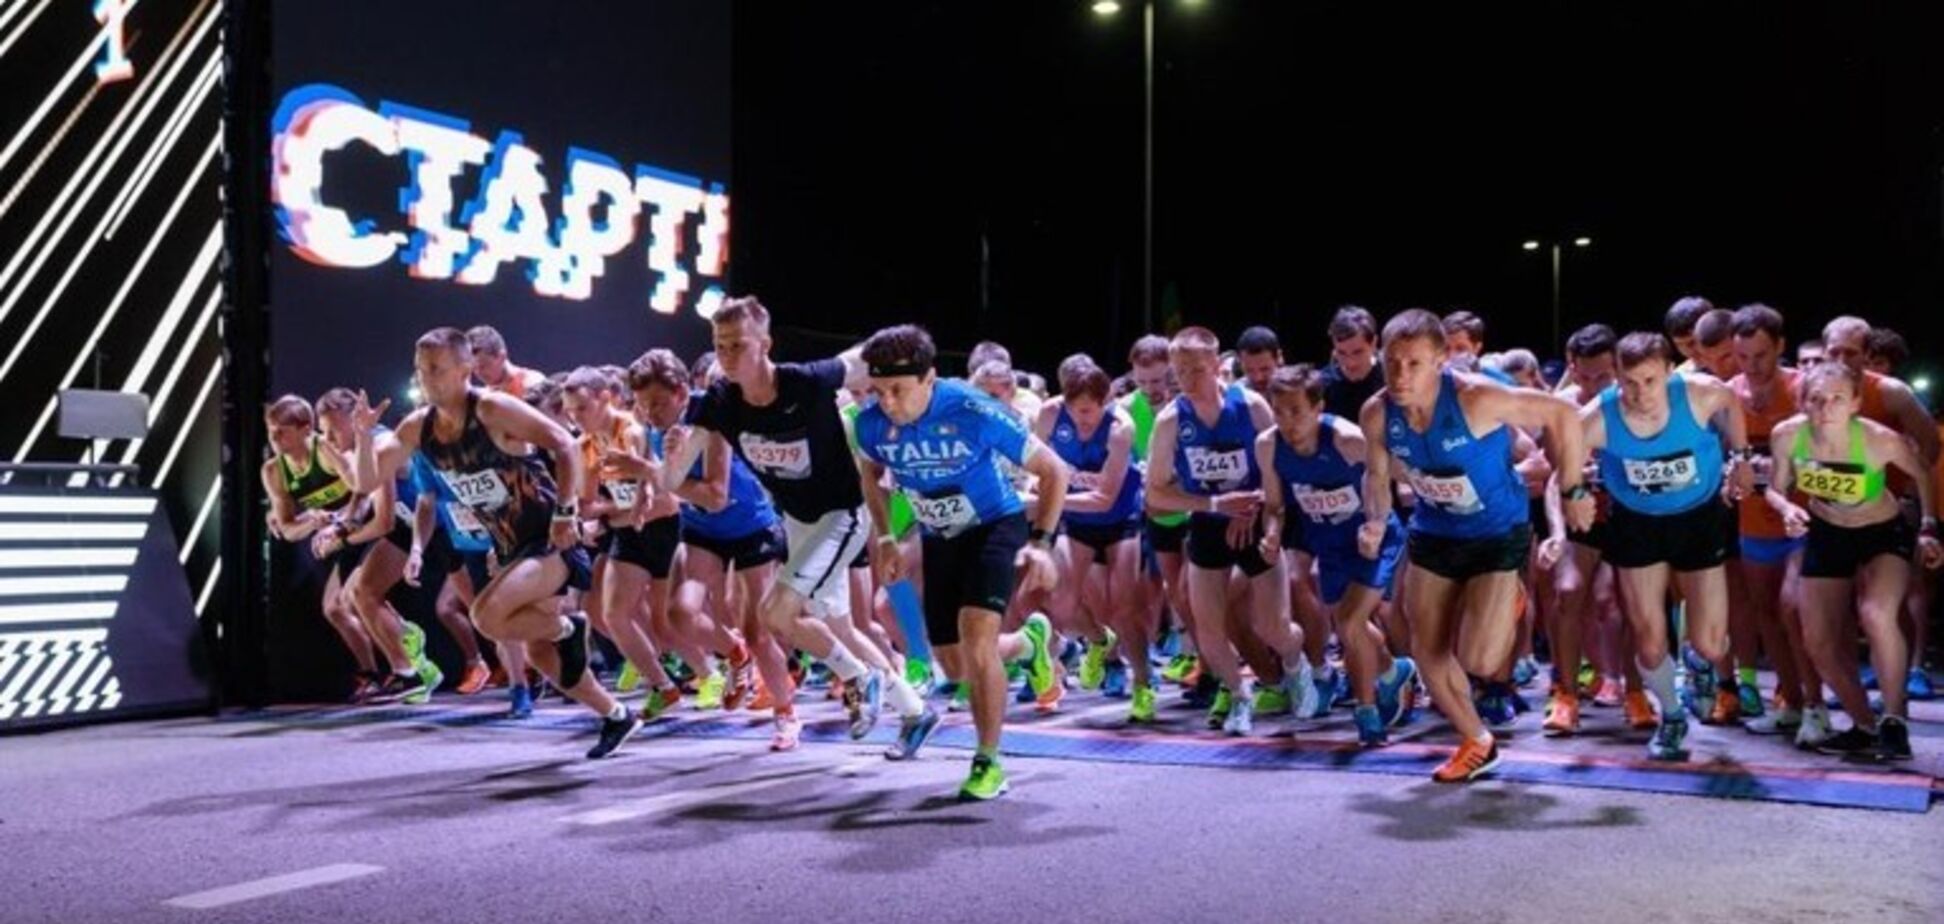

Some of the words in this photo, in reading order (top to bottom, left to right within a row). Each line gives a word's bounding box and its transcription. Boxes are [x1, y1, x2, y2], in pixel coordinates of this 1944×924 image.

[271, 84, 730, 319] СТАРТ!
[749, 445, 802, 464] 5379
[875, 440, 973, 462] ITALIA
[1193, 455, 1239, 474] 2441
[1633, 461, 1688, 480] 5268
[1802, 472, 1856, 495] 2822
